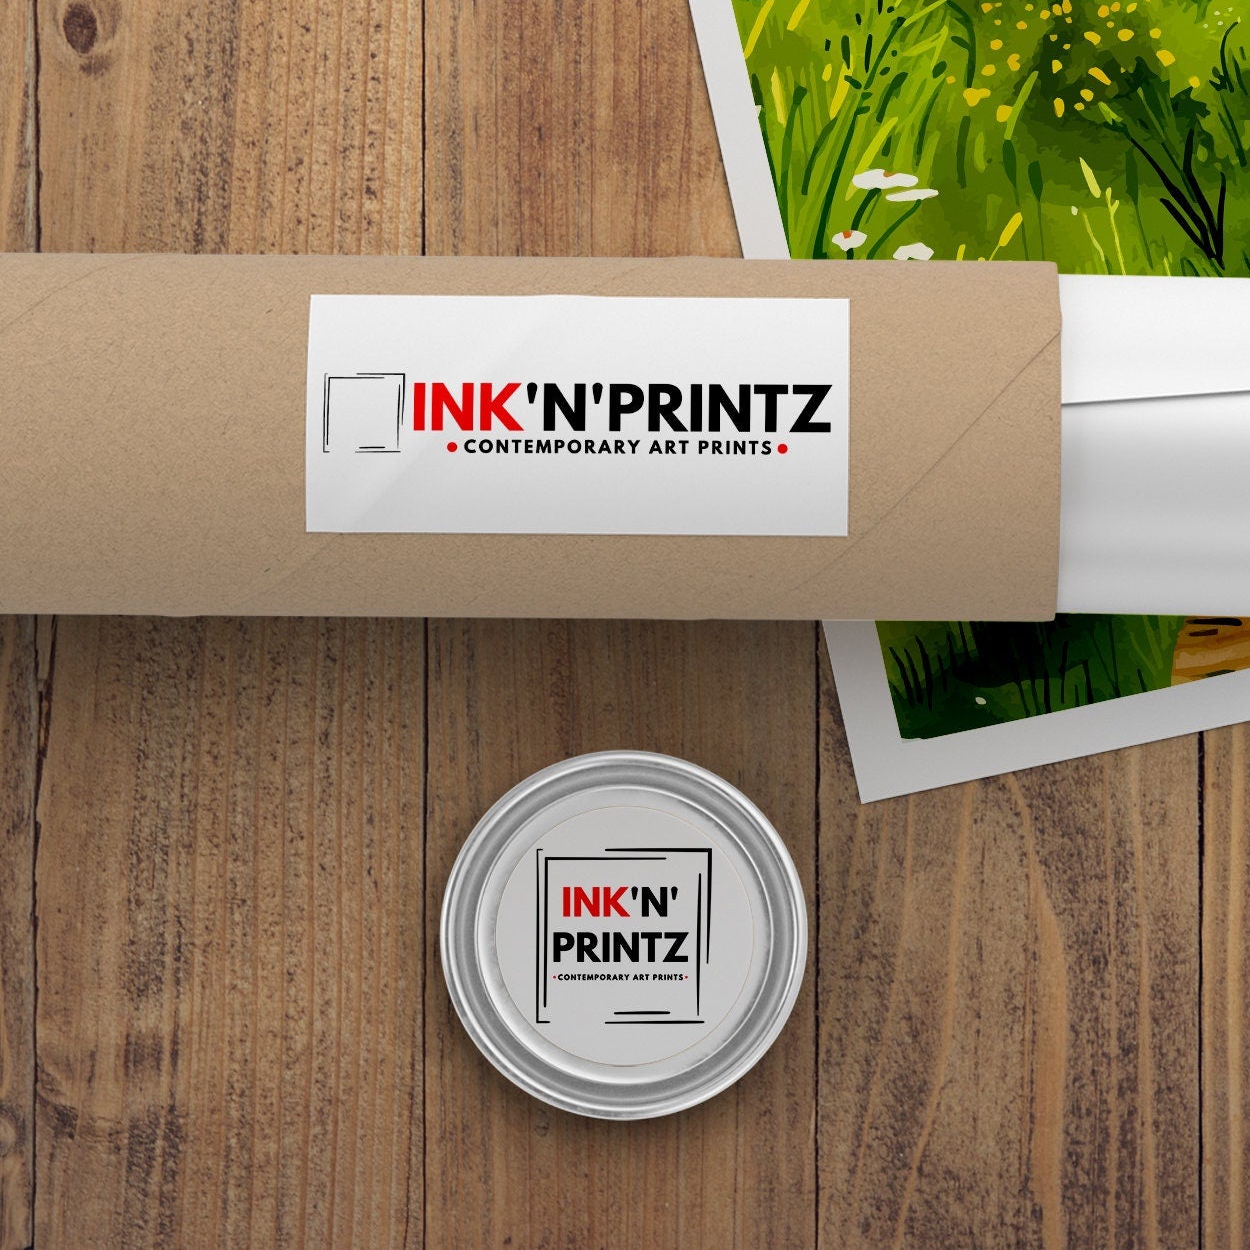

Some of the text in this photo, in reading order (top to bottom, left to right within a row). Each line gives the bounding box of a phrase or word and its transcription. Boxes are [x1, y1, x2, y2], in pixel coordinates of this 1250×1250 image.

[463, 438, 772, 456] CONTEMPORARY ART PRINTS
[562, 885, 679, 918] INK'N'
[552, 931, 690, 963] PRINTZ
[557, 973, 684, 981] CONTEMPORARY ART PRINTS
